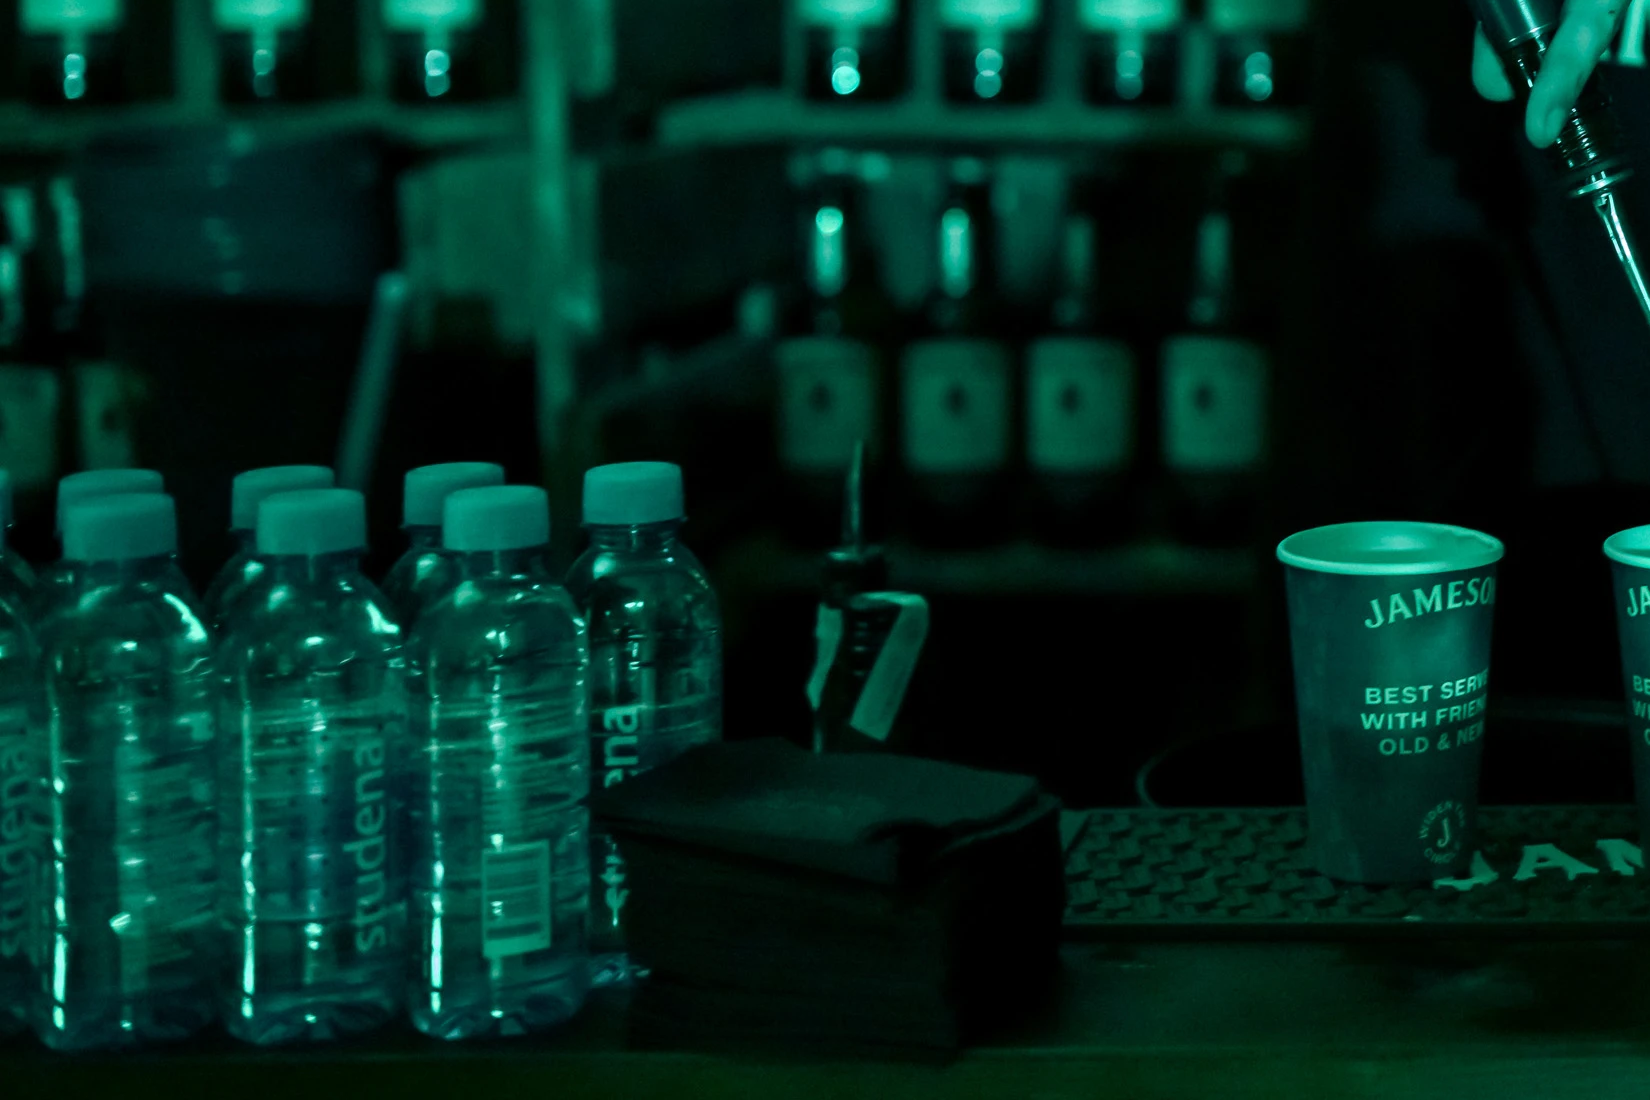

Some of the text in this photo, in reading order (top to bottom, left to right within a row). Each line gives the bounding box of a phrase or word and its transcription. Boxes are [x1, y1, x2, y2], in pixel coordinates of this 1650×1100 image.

[1364, 576, 1496, 629] JAMESO
[1365, 685, 1433, 705] BEST
[1361, 712, 1427, 730] WITH
[1379, 737, 1429, 756] OLD
[1437, 732, 1451, 751] &
